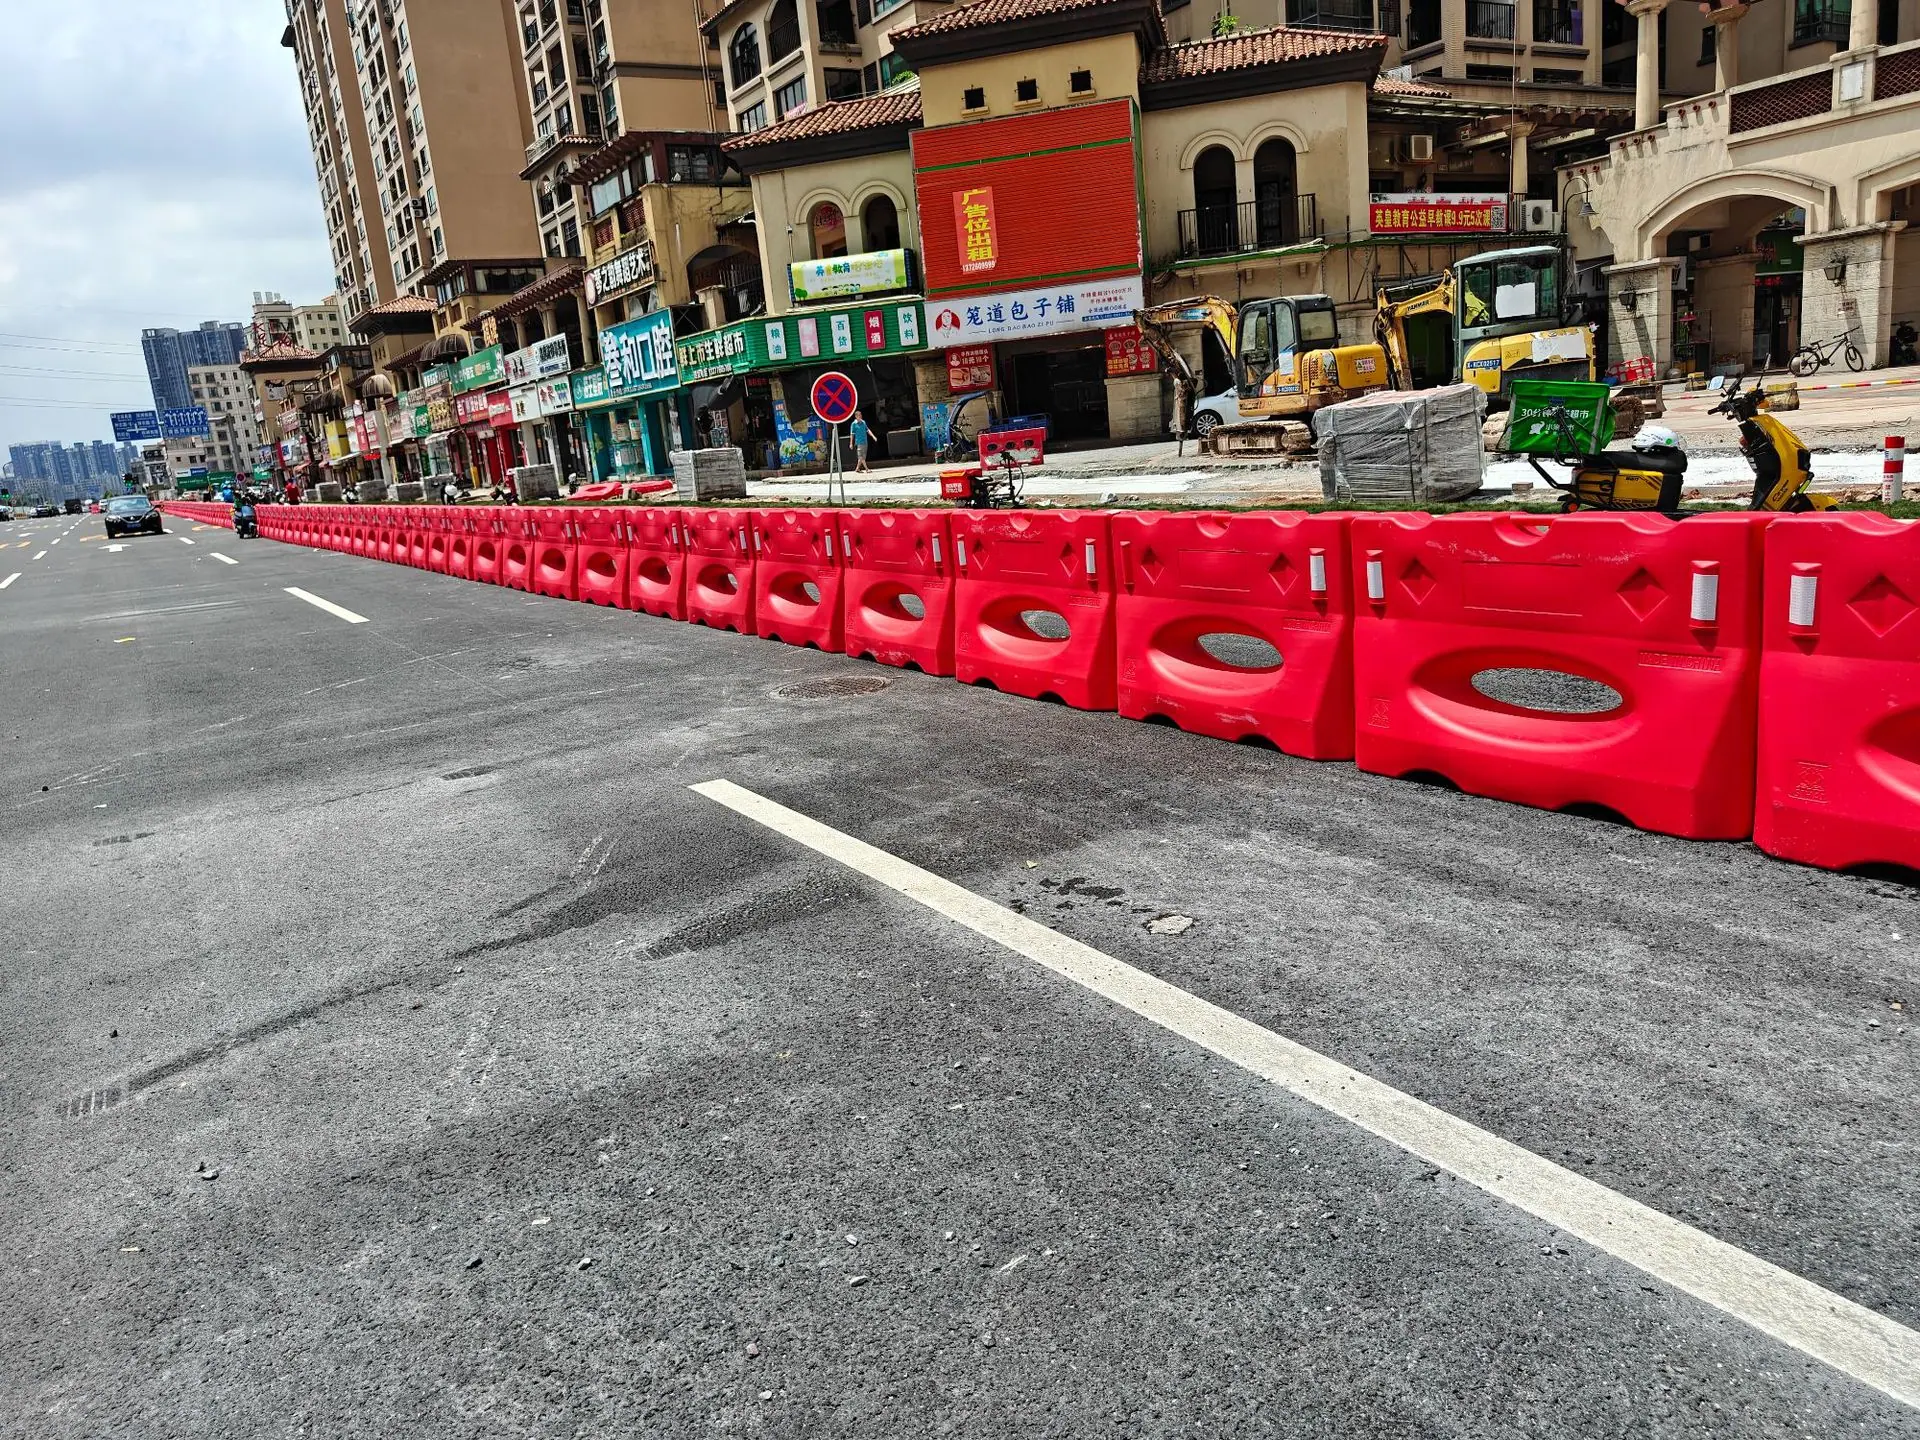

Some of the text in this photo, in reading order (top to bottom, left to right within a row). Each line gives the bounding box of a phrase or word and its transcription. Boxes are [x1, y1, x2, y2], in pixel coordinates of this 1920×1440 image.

[962, 189, 994, 261] 广告位出租
[1375, 208, 1491, 228] 英皇教育公益早教课9.9元5次课
[966, 294, 1075, 326] 笼道包子铺
[835, 320, 848, 347] 百货
[868, 316, 882, 345] 烟酒
[902, 312, 914, 340] 饮料
[770, 328, 782, 354] 粮油
[1521, 408, 1590, 419] 30分钟超市
